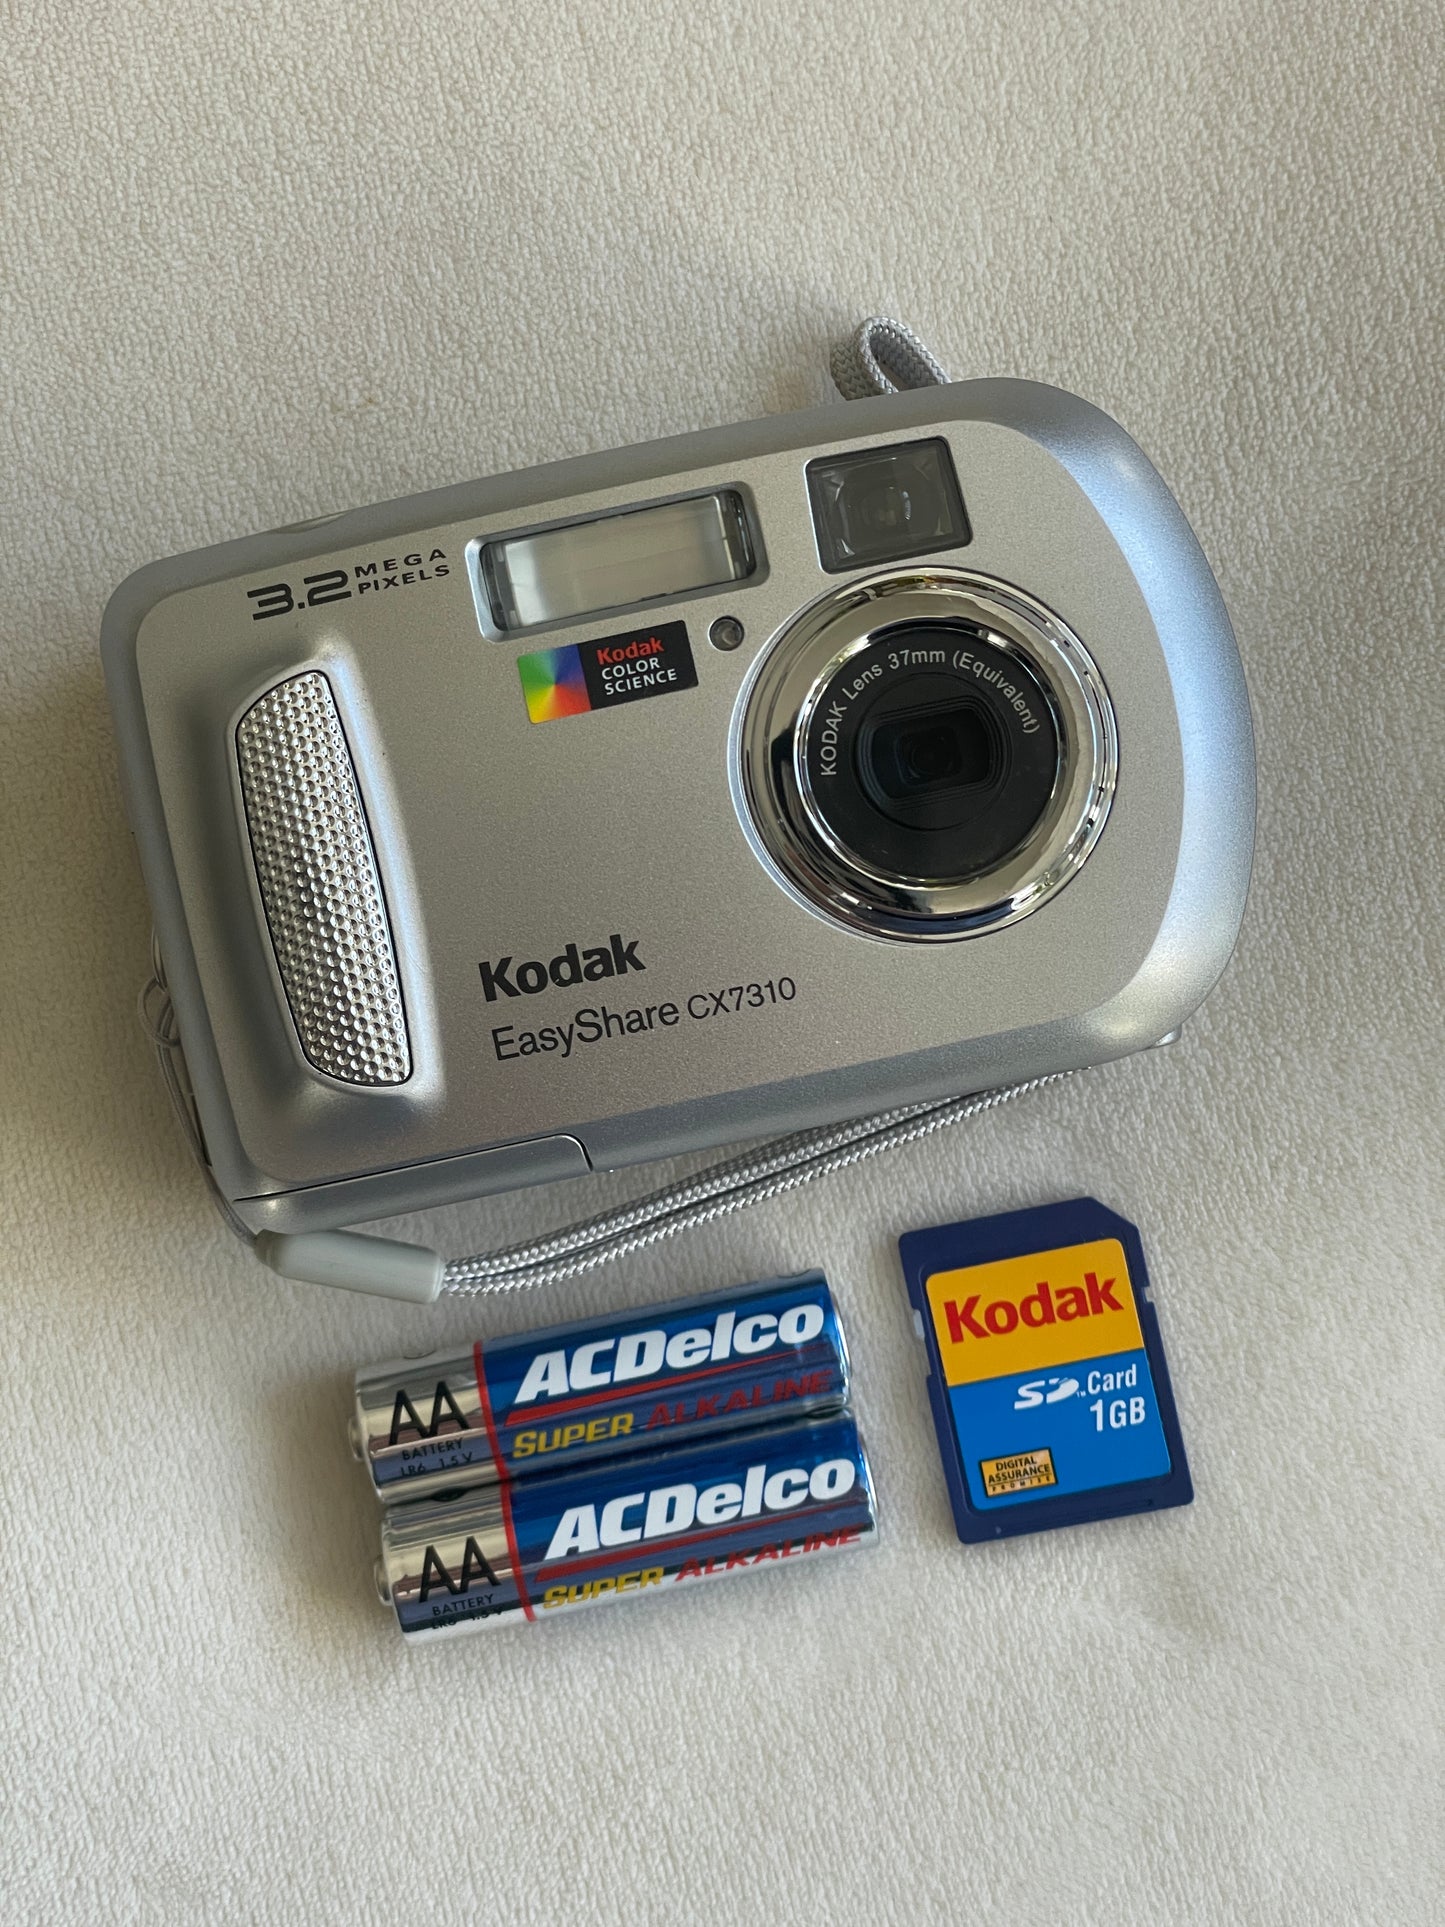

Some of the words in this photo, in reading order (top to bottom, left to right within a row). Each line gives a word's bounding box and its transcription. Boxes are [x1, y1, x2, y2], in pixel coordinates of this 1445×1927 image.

[354, 548, 447, 578] MEGA
[358, 564, 450, 594] PIXELS
[247, 569, 352, 621] 3.2
[596, 636, 665, 665] Kodak
[601, 657, 660, 680] COLOR
[604, 668, 678, 695] SCIENCE
[820, 701, 848, 776] KODAK
[841, 663, 883, 700] Lens
[888, 650, 946, 670] 37mm
[952, 650, 1041, 734] (Equivalent)
[478, 933, 647, 1002] Kodak
[491, 1002, 680, 1061] EasyShare
[687, 977, 797, 1020] CX7310
[943, 1271, 1125, 1344] Kodak
[513, 1303, 824, 1405] ACDelco
[1014, 1377, 1080, 1410] SD
[1087, 1363, 1137, 1395] Card
[389, 1380, 471, 1446] AA
[512, 1413, 634, 1459] SUPER
[646, 1371, 833, 1431] ALKALINE
[1089, 1396, 1146, 1432] 1GB
[401, 1437, 463, 1461] BATTERY
[988, 1463, 1050, 1484] ASSURANCE
[995, 1455, 1038, 1472] DIGITAL
[543, 1458, 856, 1562] ACDelco
[418, 1535, 502, 1603] AA
[543, 1566, 665, 1610] SUPER
[675, 1523, 866, 1582] ALKALINE
[432, 1593, 494, 1616] BATTERY
